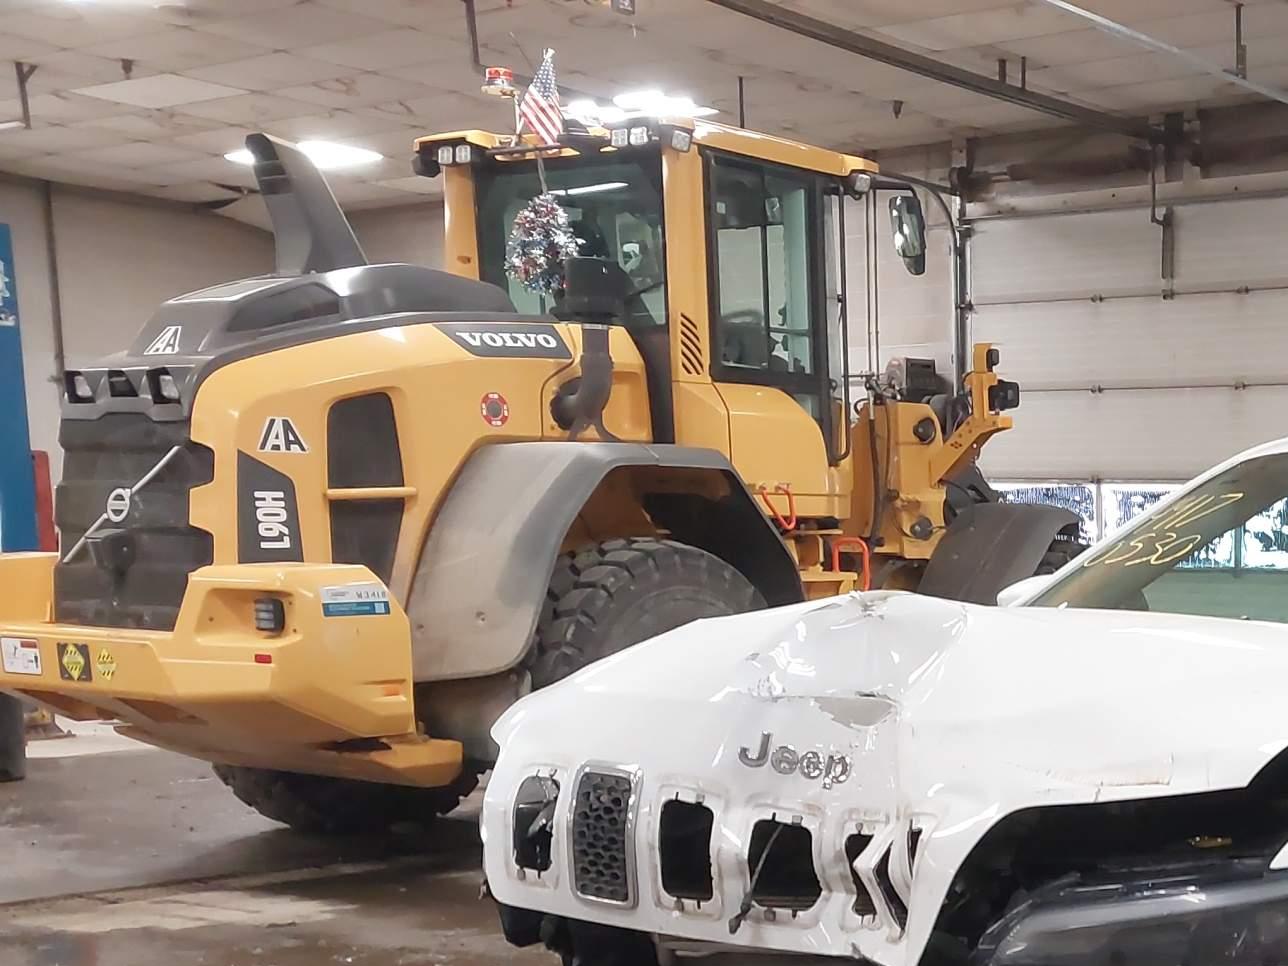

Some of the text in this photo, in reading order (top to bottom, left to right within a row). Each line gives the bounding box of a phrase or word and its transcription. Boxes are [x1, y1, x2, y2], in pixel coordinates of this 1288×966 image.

[456, 332, 557, 348] VOLVO
[254, 490, 291, 549] L90H
[739, 730, 851, 790] Jeep
